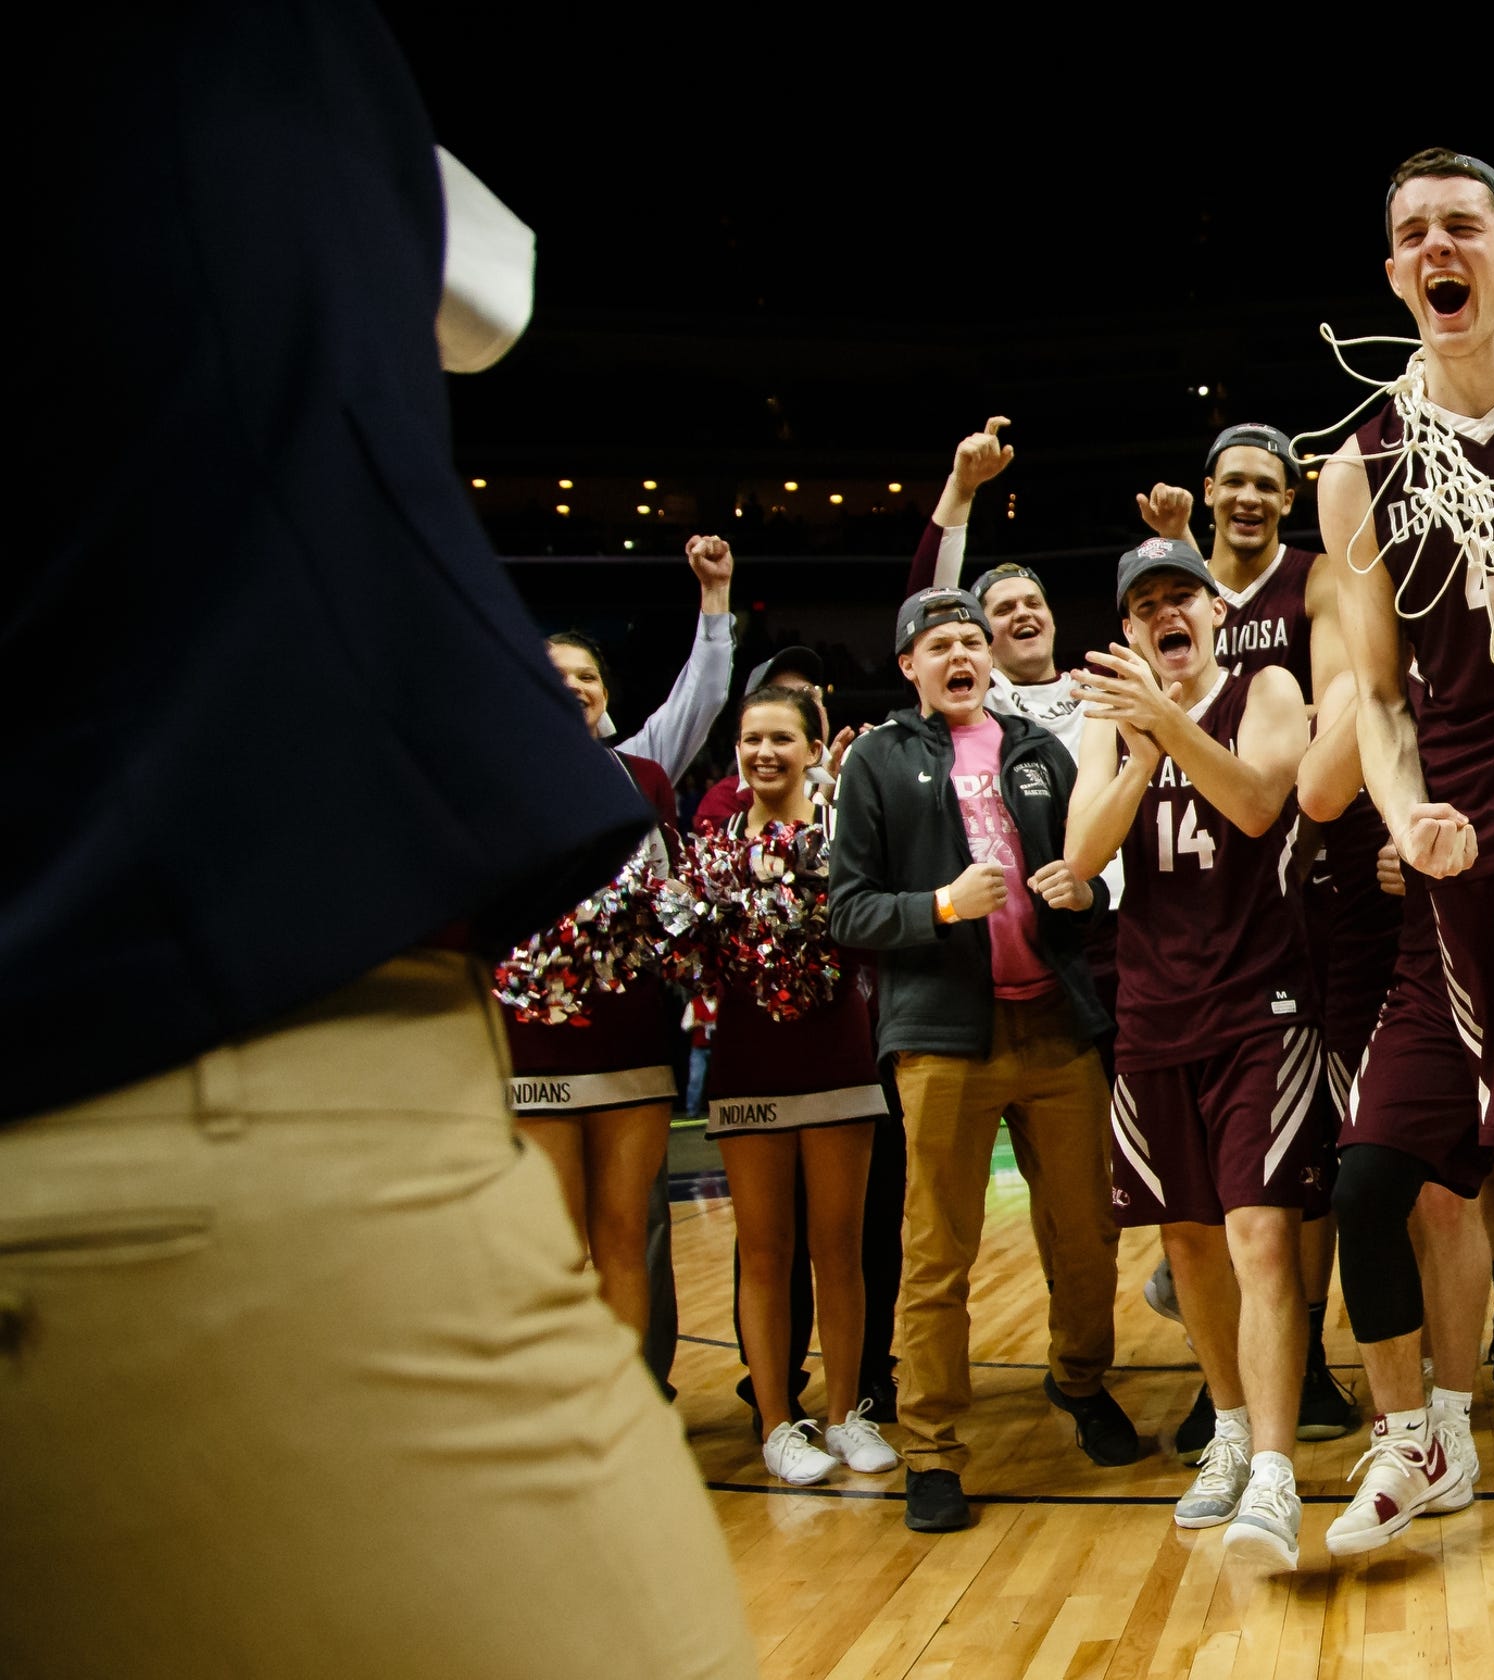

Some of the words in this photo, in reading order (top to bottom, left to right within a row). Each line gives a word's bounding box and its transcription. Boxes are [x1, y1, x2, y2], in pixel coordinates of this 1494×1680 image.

[1156, 799, 1217, 872] 14
[1275, 990, 1288, 1000] M
[719, 1103, 778, 1126] INDIANS
